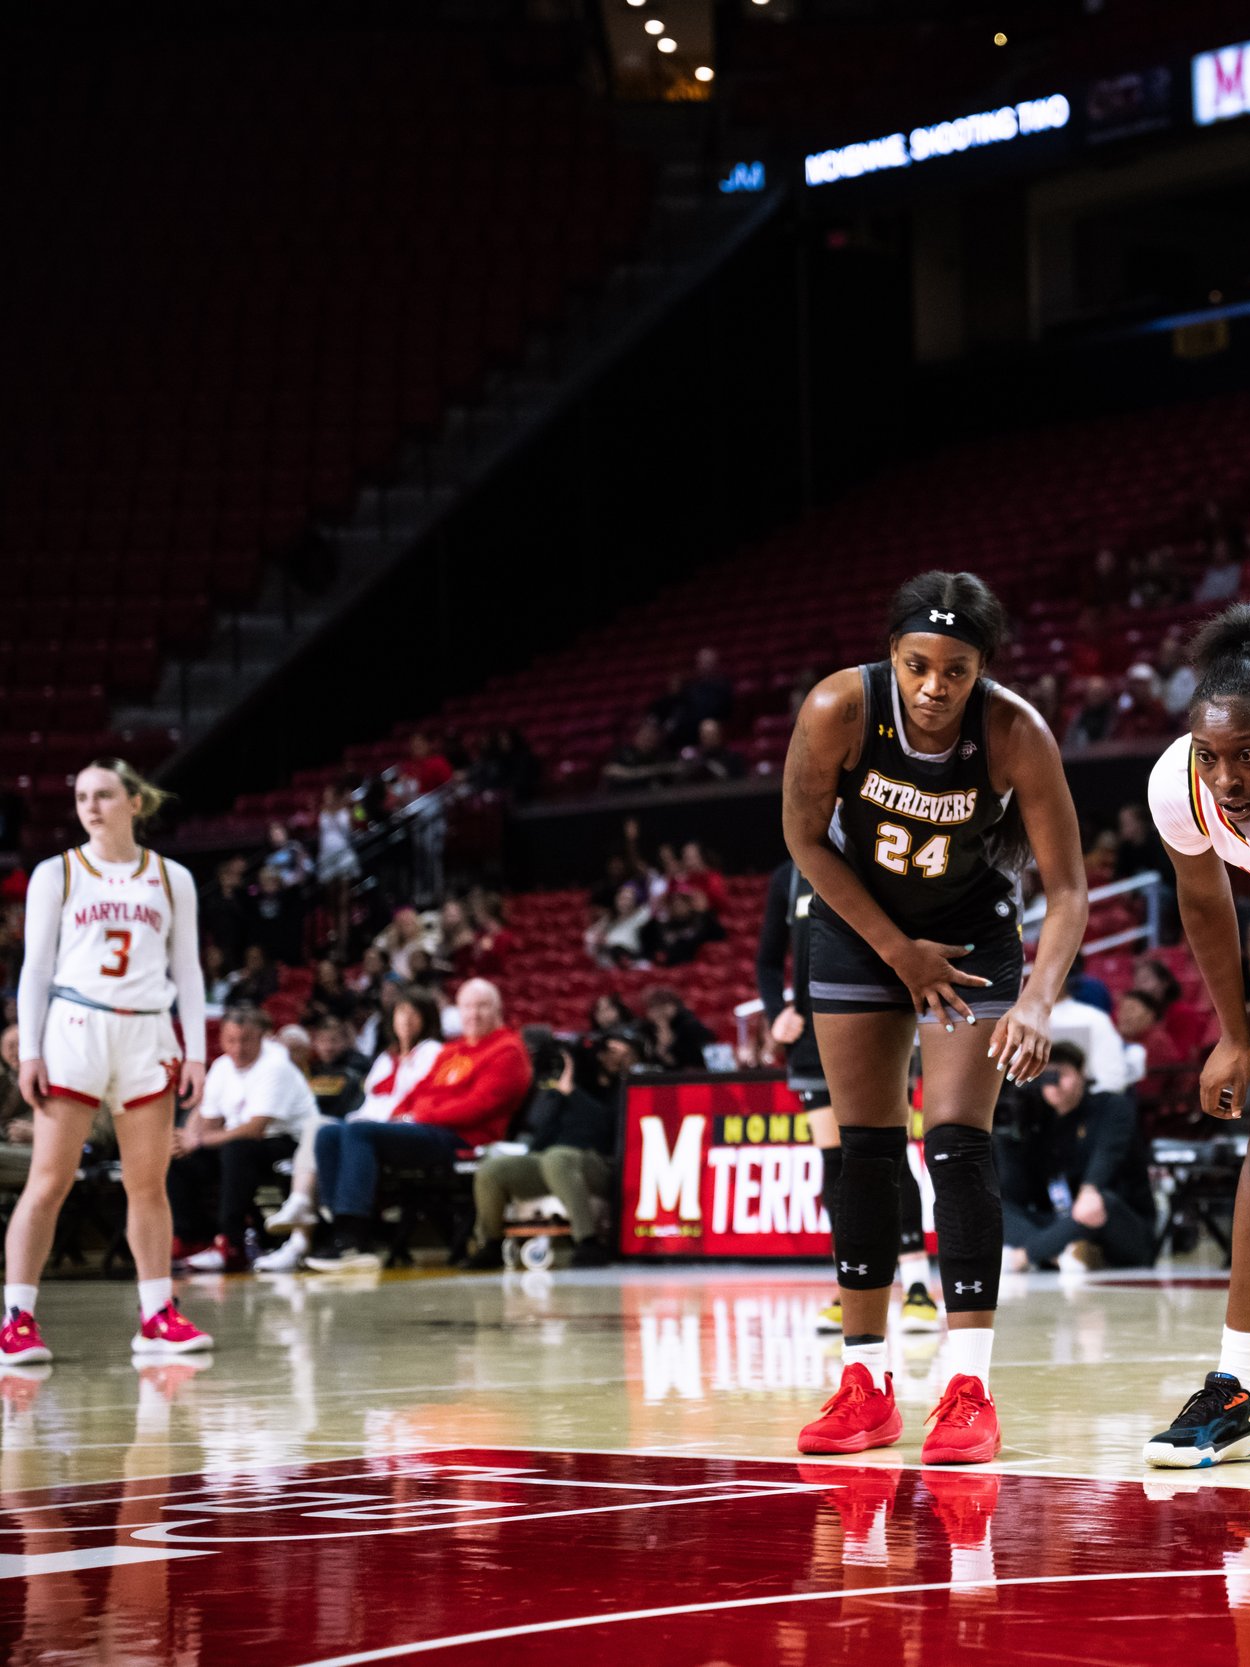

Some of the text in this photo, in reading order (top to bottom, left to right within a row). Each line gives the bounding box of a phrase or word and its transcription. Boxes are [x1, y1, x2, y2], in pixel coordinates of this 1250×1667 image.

[860, 770, 978, 824] RETRIEVERS
[875, 822, 951, 878] 24
[75, 902, 163, 934] MARYLAND
[100, 928, 132, 978] 3
[635, 1114, 706, 1221] M
[708, 1146, 832, 1234] TERR
